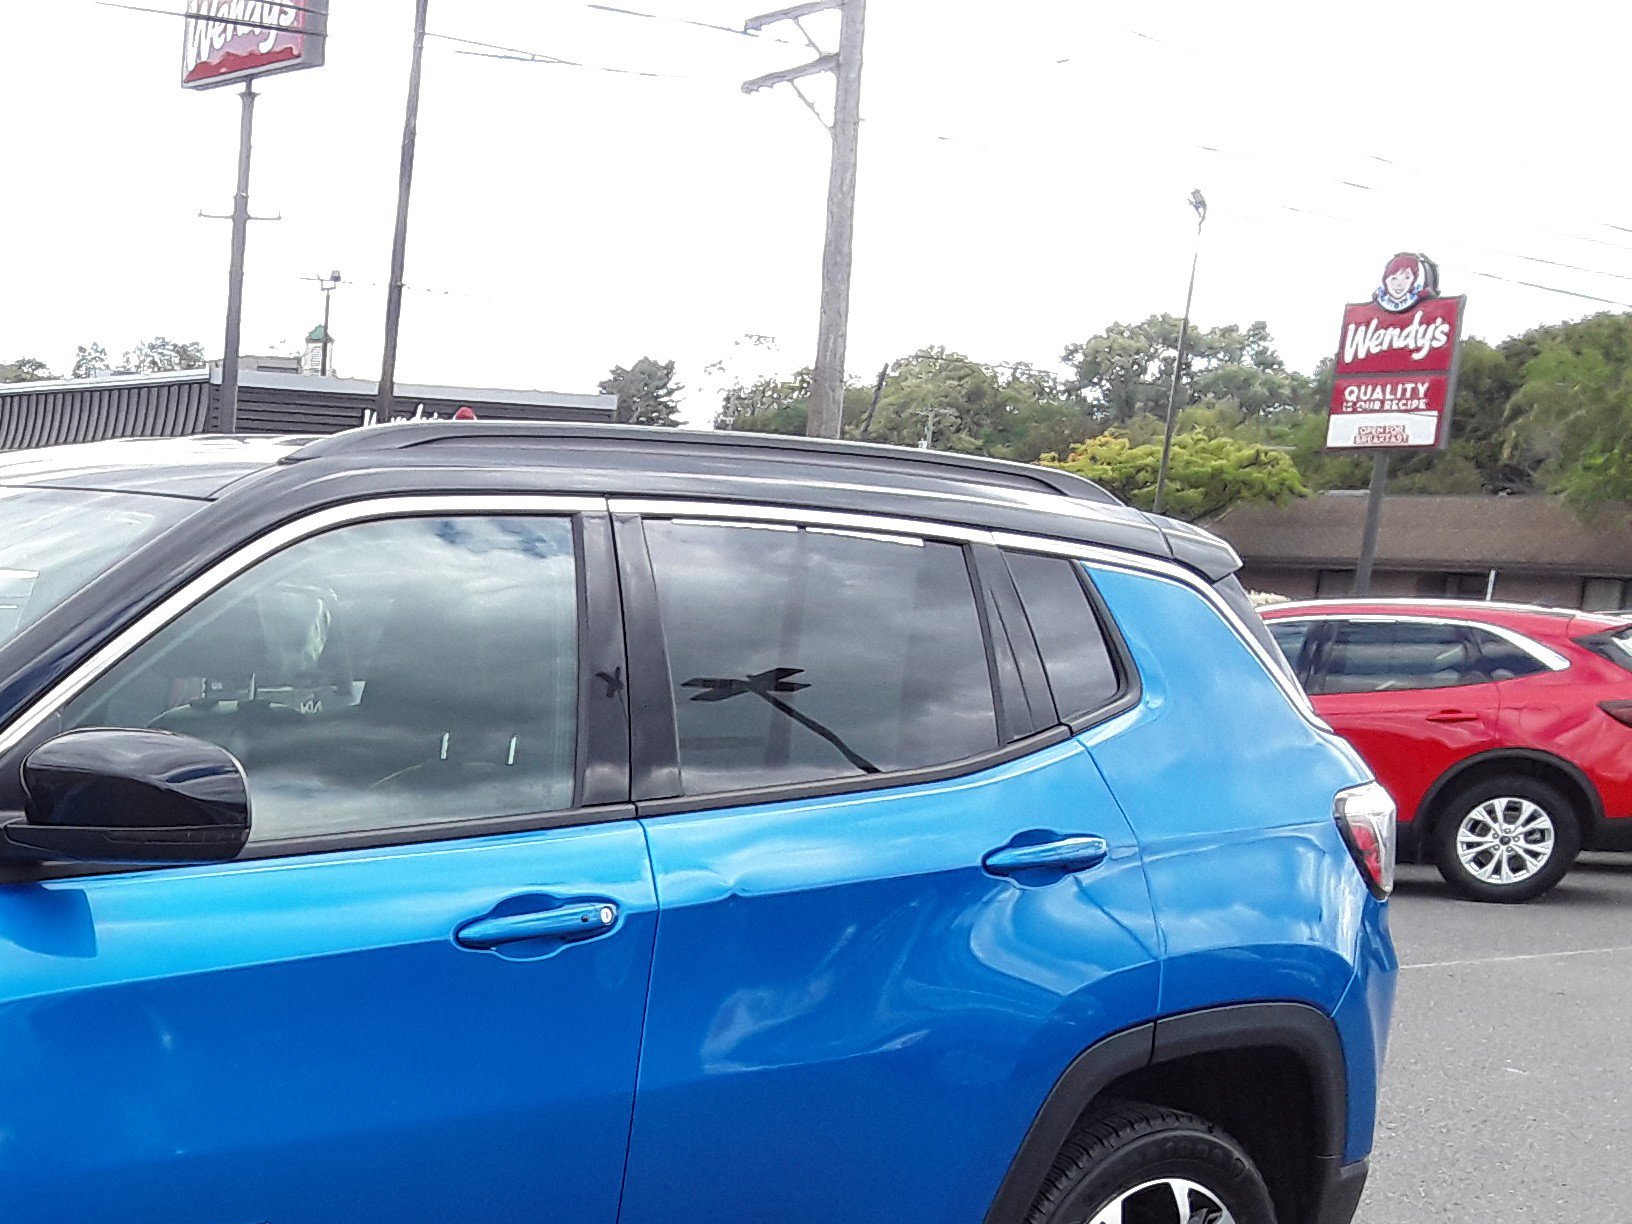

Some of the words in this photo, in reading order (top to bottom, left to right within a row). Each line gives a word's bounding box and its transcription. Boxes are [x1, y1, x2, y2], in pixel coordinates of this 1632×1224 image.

[186, 0, 297, 71] Wendys
[1343, 310, 1450, 364] Wendy's
[1343, 402, 1354, 412] IS
[1356, 400, 1381, 411] OUR
[1383, 399, 1428, 411] RECIPE
[1344, 382, 1430, 401] QUALITY
